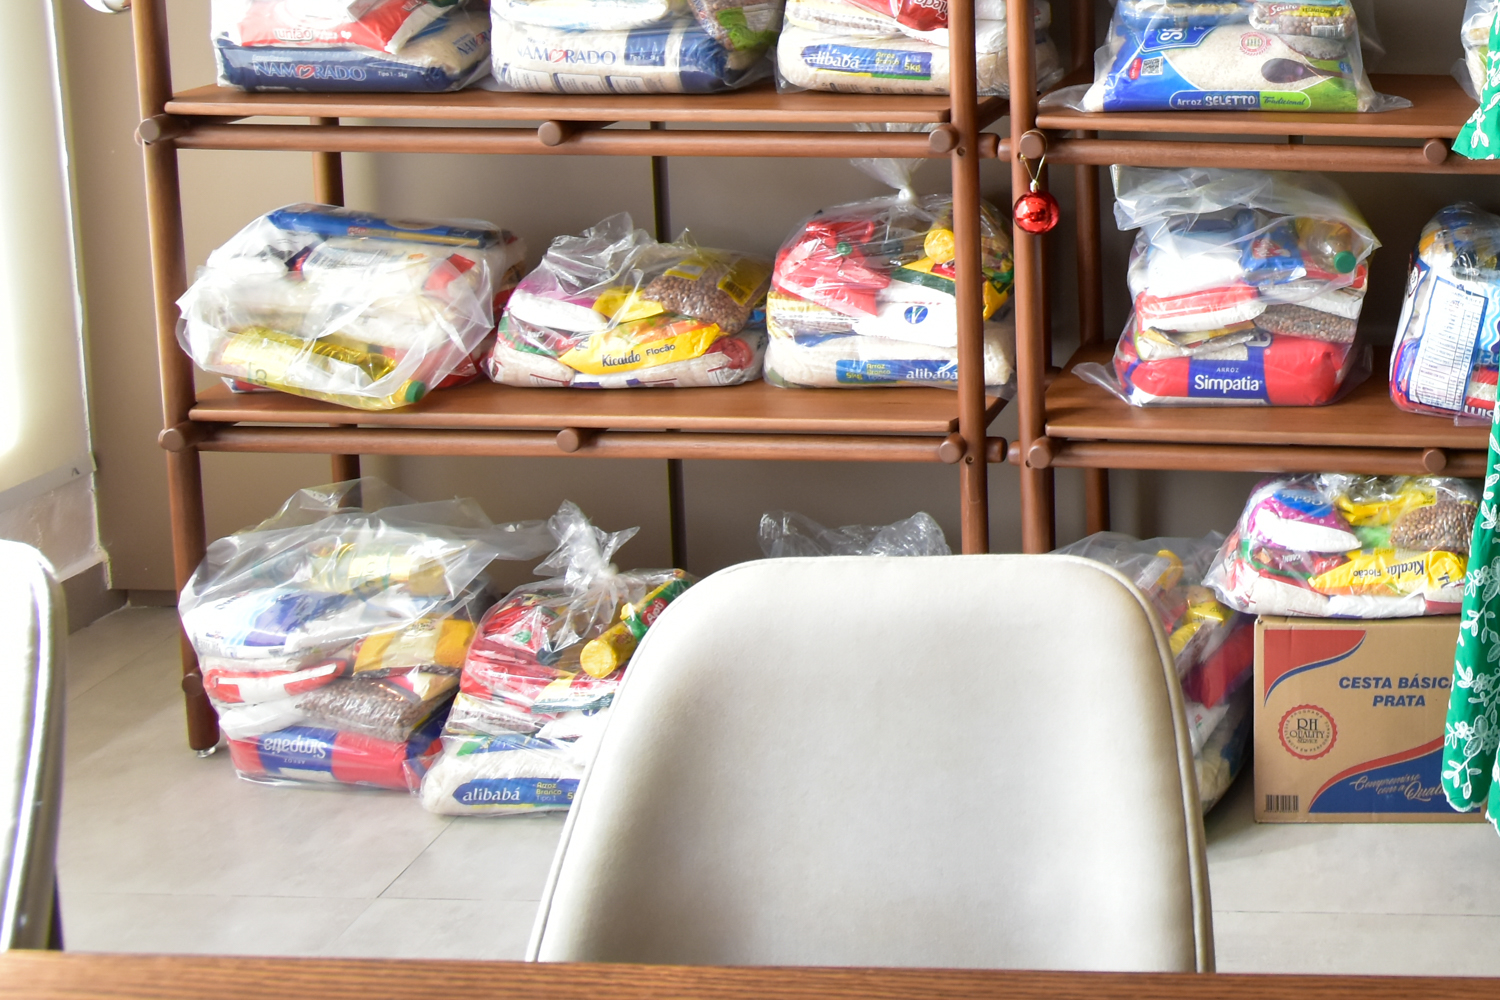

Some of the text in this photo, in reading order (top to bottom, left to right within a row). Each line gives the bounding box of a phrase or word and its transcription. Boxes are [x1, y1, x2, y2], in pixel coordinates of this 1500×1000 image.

[806, 50, 860, 69] alibabá
[252, 61, 367, 82] NAMORADO
[378, 70, 390, 78] Tipo
[1204, 95, 1256, 107] SELETTO
[1262, 96, 1306, 106] Tradicional
[601, 343, 676, 368] Kicaldo Flocão
[1194, 374, 1260, 394] Simpatia
[1353, 569, 1382, 578] Flocão
[646, 602, 665, 625] Apti
[1338, 673, 1452, 690] CESTA BÁSIC
[1372, 695, 1426, 707] PRATA
[1297, 718, 1318, 731] RH
[1289, 730, 1325, 739] QUALITY
[263, 735, 328, 759] Simpatia
[1349, 773, 1421, 792] Compromisso
[462, 786, 520, 802] alibabá
[536, 788, 562, 796] Branco
